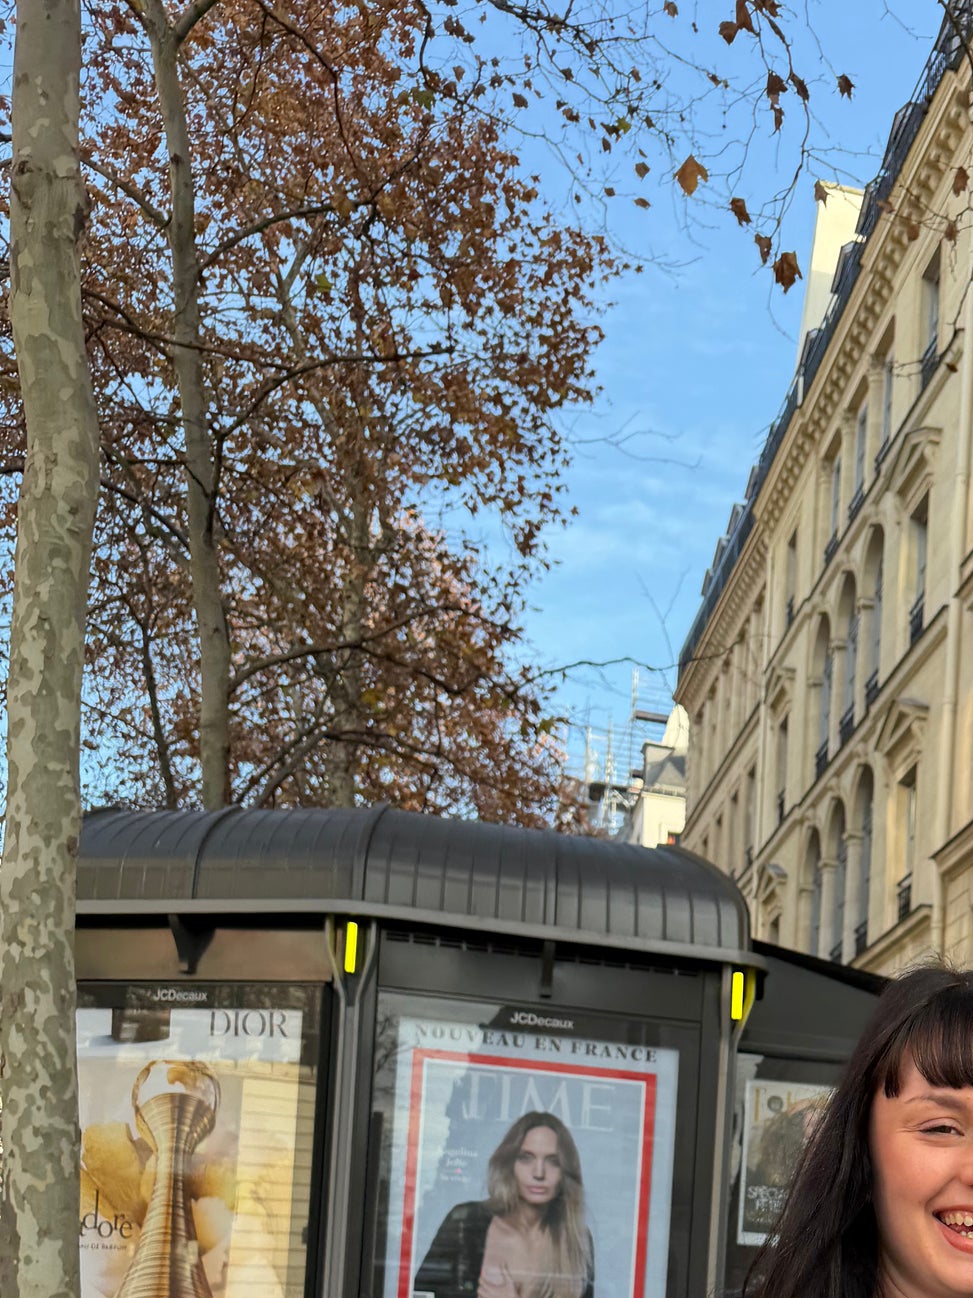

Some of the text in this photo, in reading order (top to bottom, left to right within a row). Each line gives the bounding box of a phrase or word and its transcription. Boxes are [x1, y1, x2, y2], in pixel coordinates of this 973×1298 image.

[153, 989, 208, 1002] JCDecaux
[210, 1010, 289, 1038] DIOR
[509, 1011, 574, 1030] JCDecaux
[415, 1024, 658, 1064] NOUVEAU EN FRANCE
[461, 1069, 618, 1133] TIME
